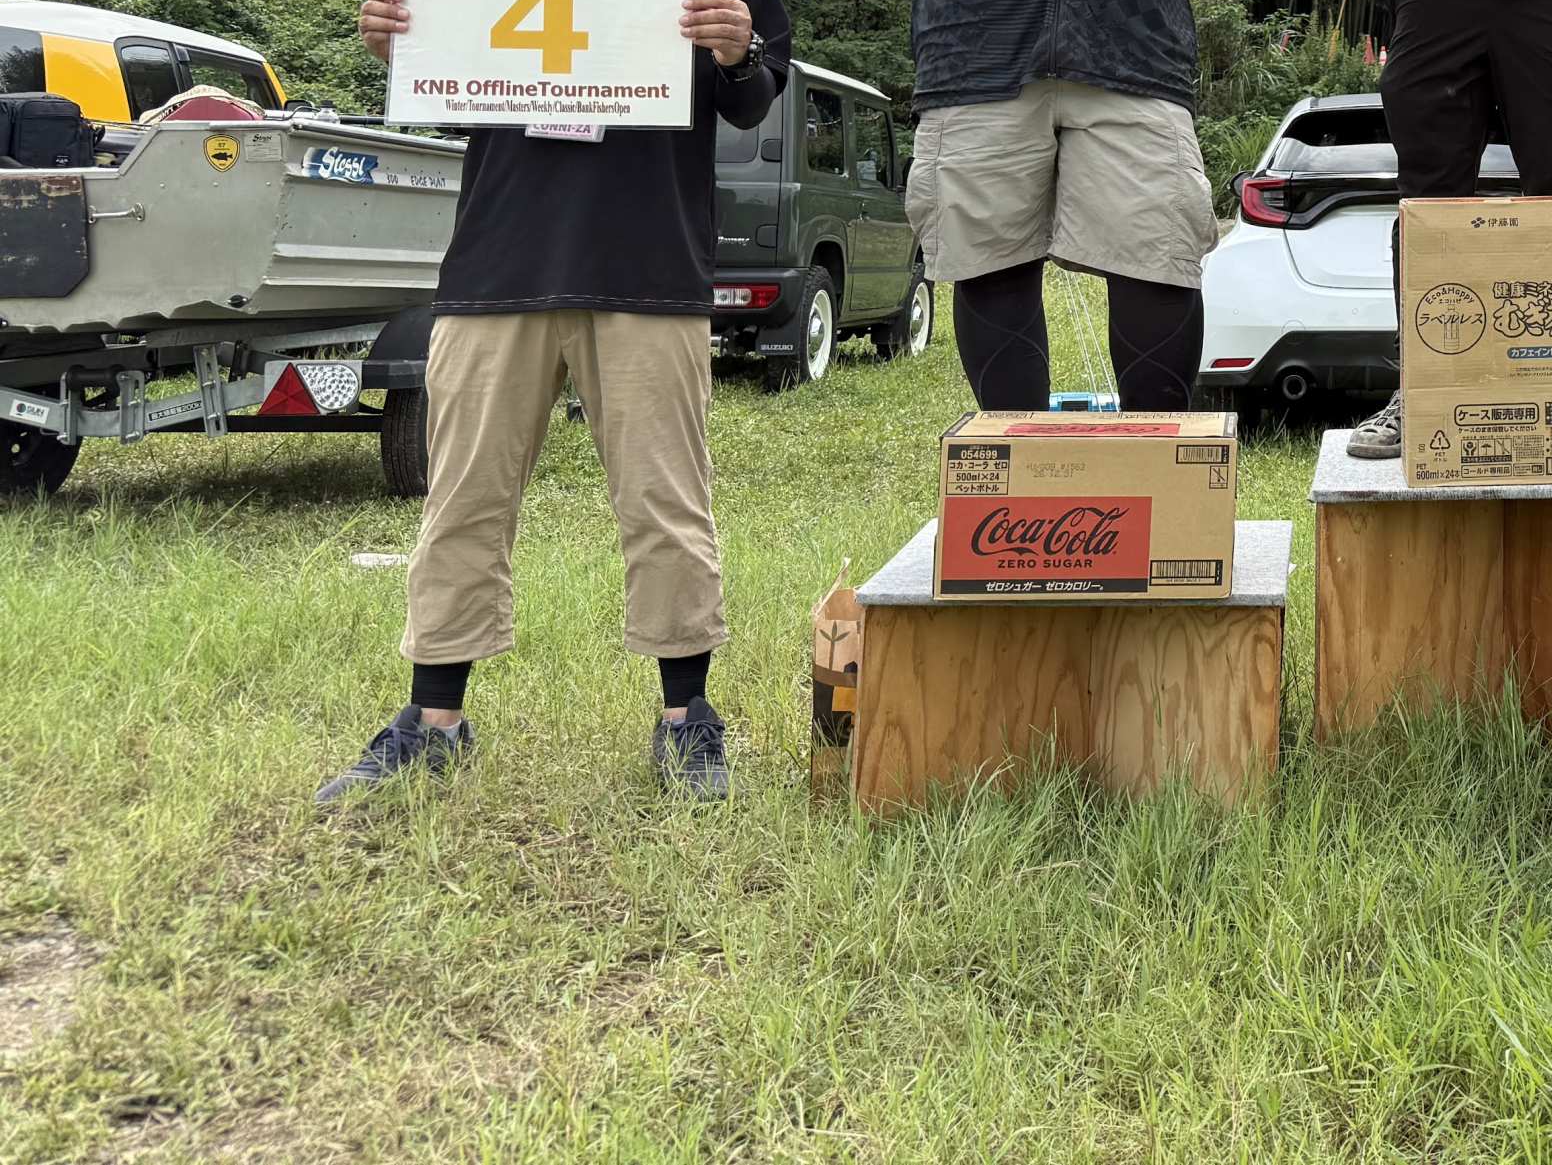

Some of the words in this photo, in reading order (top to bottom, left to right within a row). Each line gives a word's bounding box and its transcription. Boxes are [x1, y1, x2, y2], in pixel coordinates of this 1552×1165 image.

[413, 79, 459, 95] KNB
[466, 80, 670, 99] OfflineTournament
[1488, 217, 1519, 227] 伊藤園
[1425, 287, 1475, 305] Eco&Happy
[1418, 313, 1484, 326] ラベルレス
[1458, 407, 1536, 421] ケース販売専用
[950, 462, 989, 470] コカ・コーラ
[994, 461, 1008, 469] ゼロ
[955, 484, 999, 492] ペットボトル
[970, 507, 1129, 556] Coca-Cola
[998, 559, 1036, 568] ZERO
[1043, 559, 1092, 568] SUGAR
[986, 582, 1041, 591] ゼロシュガー
